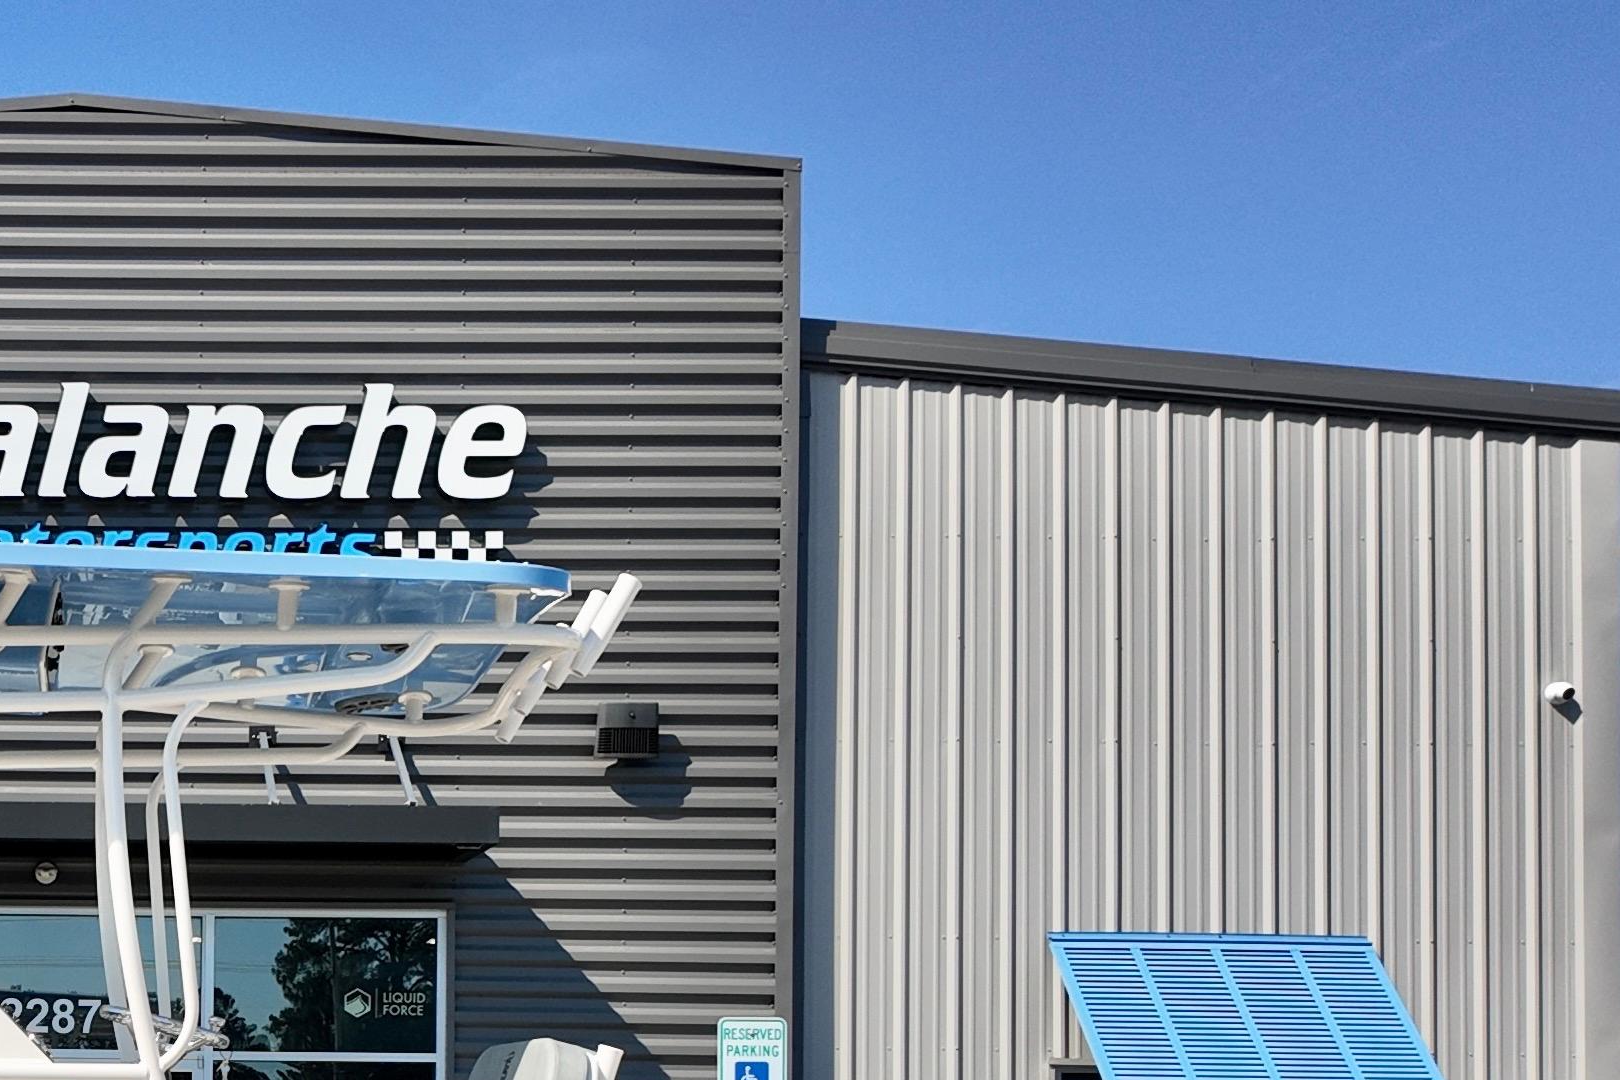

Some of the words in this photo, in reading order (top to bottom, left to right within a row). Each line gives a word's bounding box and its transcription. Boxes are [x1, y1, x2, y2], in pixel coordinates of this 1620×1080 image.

[382, 991, 426, 1005] LIQUID
[382, 1004, 424, 1016] FORCE
[723, 1028, 782, 1041] RESERVED
[726, 1045, 780, 1057] PARKING
